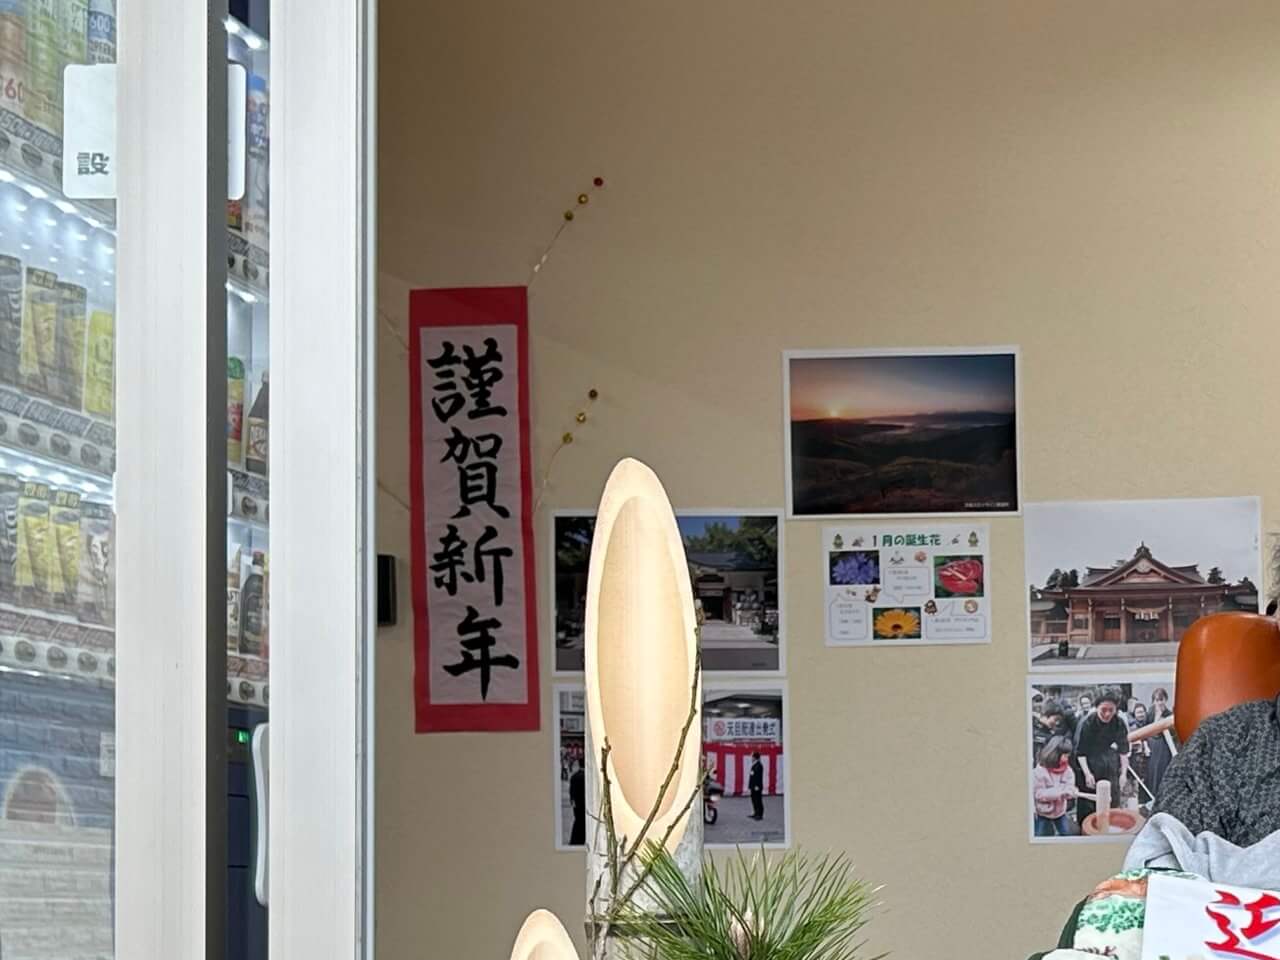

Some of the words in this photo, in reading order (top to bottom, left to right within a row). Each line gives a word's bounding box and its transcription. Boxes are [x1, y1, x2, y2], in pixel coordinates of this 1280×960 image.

[77, 152, 110, 176] 設
[427, 337, 519, 701] 謹賀新年
